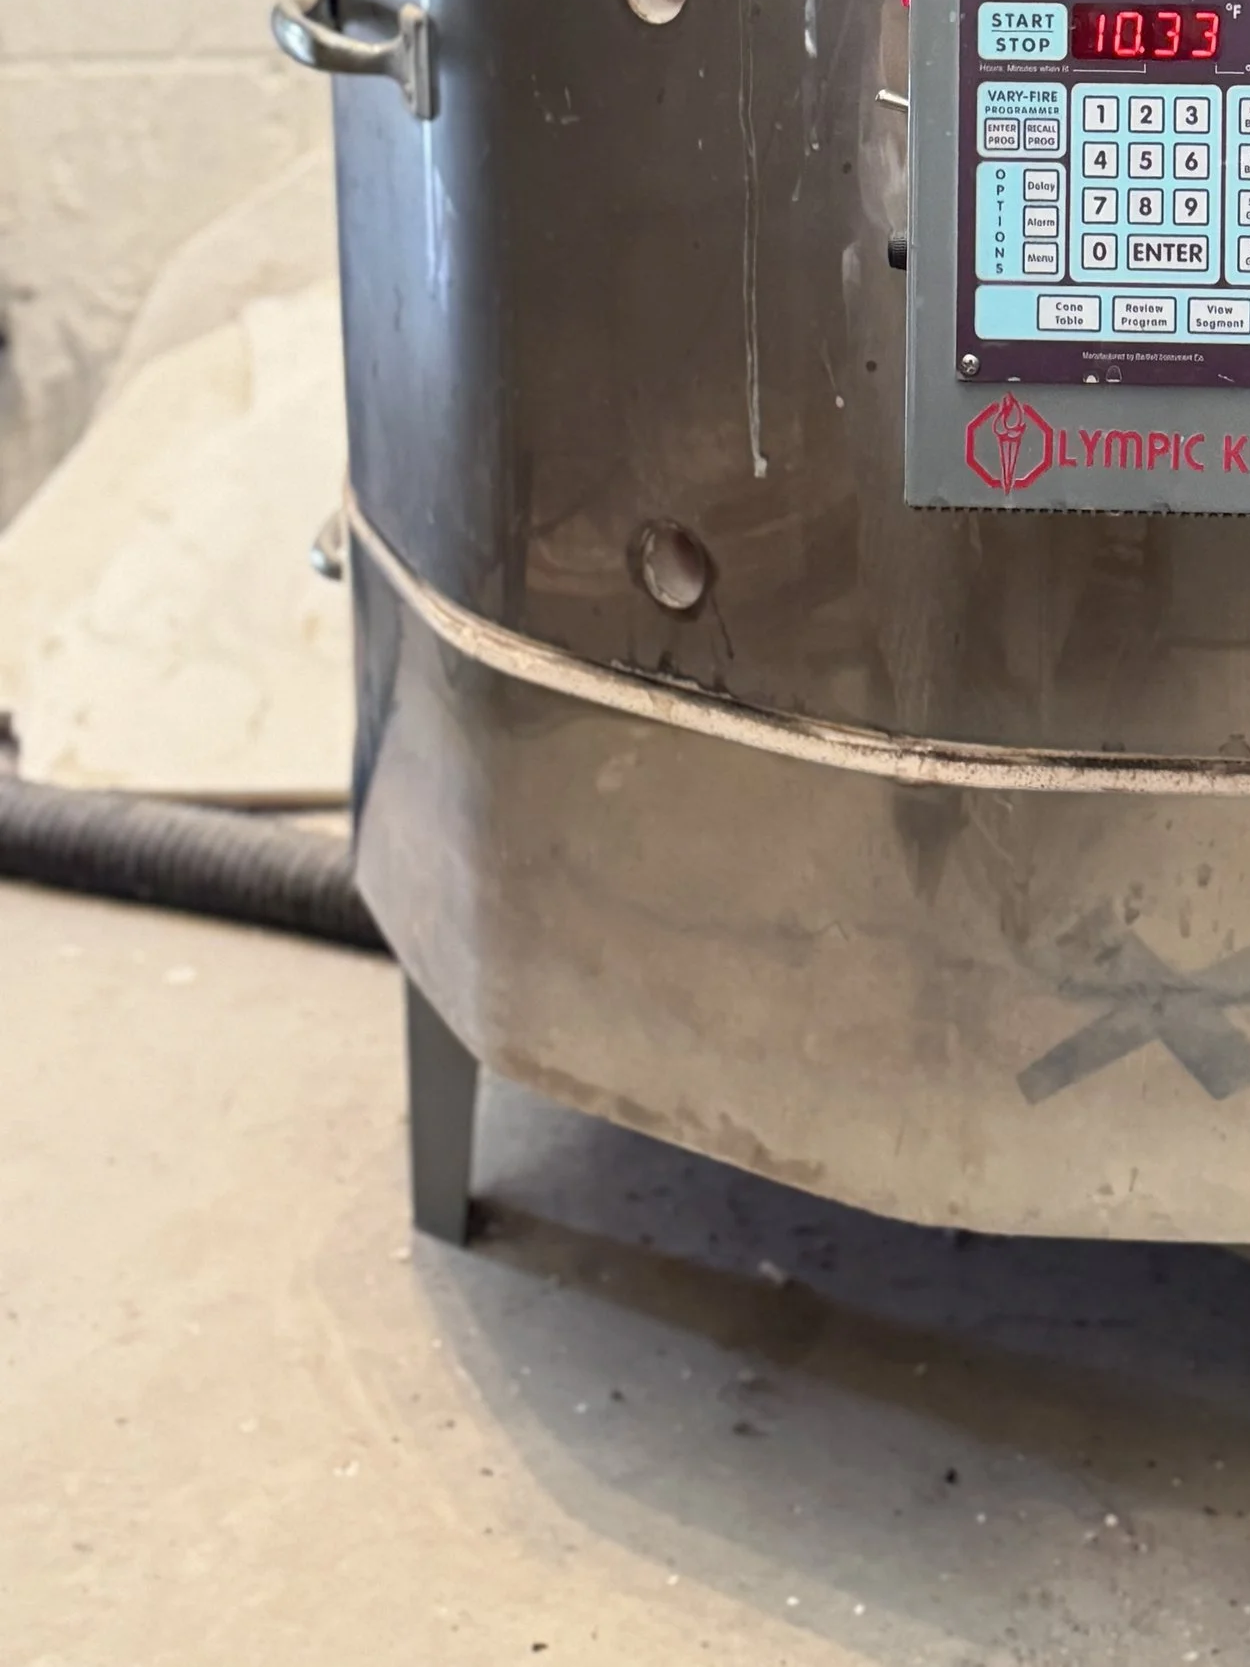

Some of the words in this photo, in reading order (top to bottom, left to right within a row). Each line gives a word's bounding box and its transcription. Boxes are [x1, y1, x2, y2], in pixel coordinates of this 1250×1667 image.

[991, 13, 1054, 29] START
[996, 37, 1050, 53] STOP
[987, 90, 1058, 102] VARY-FIRE
[985, 106, 1060, 114] PROGRAMMER
[1096, 105, 1105, 123] 1
[1140, 105, 1153, 124] 2
[1186, 105, 1198, 125] 3
[987, 124, 1016, 133] ENTER
[1027, 124, 1056, 133] RECALL
[988, 136, 1015, 145] PROG
[1028, 137, 1055, 146] PROG
[1094, 150, 1107, 169] 4
[1140, 151, 1153, 170] 5
[1185, 152, 1198, 171] 6
[1027, 181, 1055, 192] Delay
[1093, 197, 1107, 215] 7
[1139, 197, 1152, 216] 8
[1185, 198, 1198, 216] 9
[995, 169, 1006, 274] OPTIONS
[1027, 218, 1055, 227] Alarm
[1027, 254, 1054, 263] Menu
[1133, 243, 1203, 263] ENTER
[1055, 303, 1083, 312] Cone
[1125, 304, 1164, 313] Review
[1207, 305, 1233, 315] View
[1055, 315, 1083, 325] Table
[1121, 317, 1167, 329] Program
[1196, 319, 1244, 330] Segment
